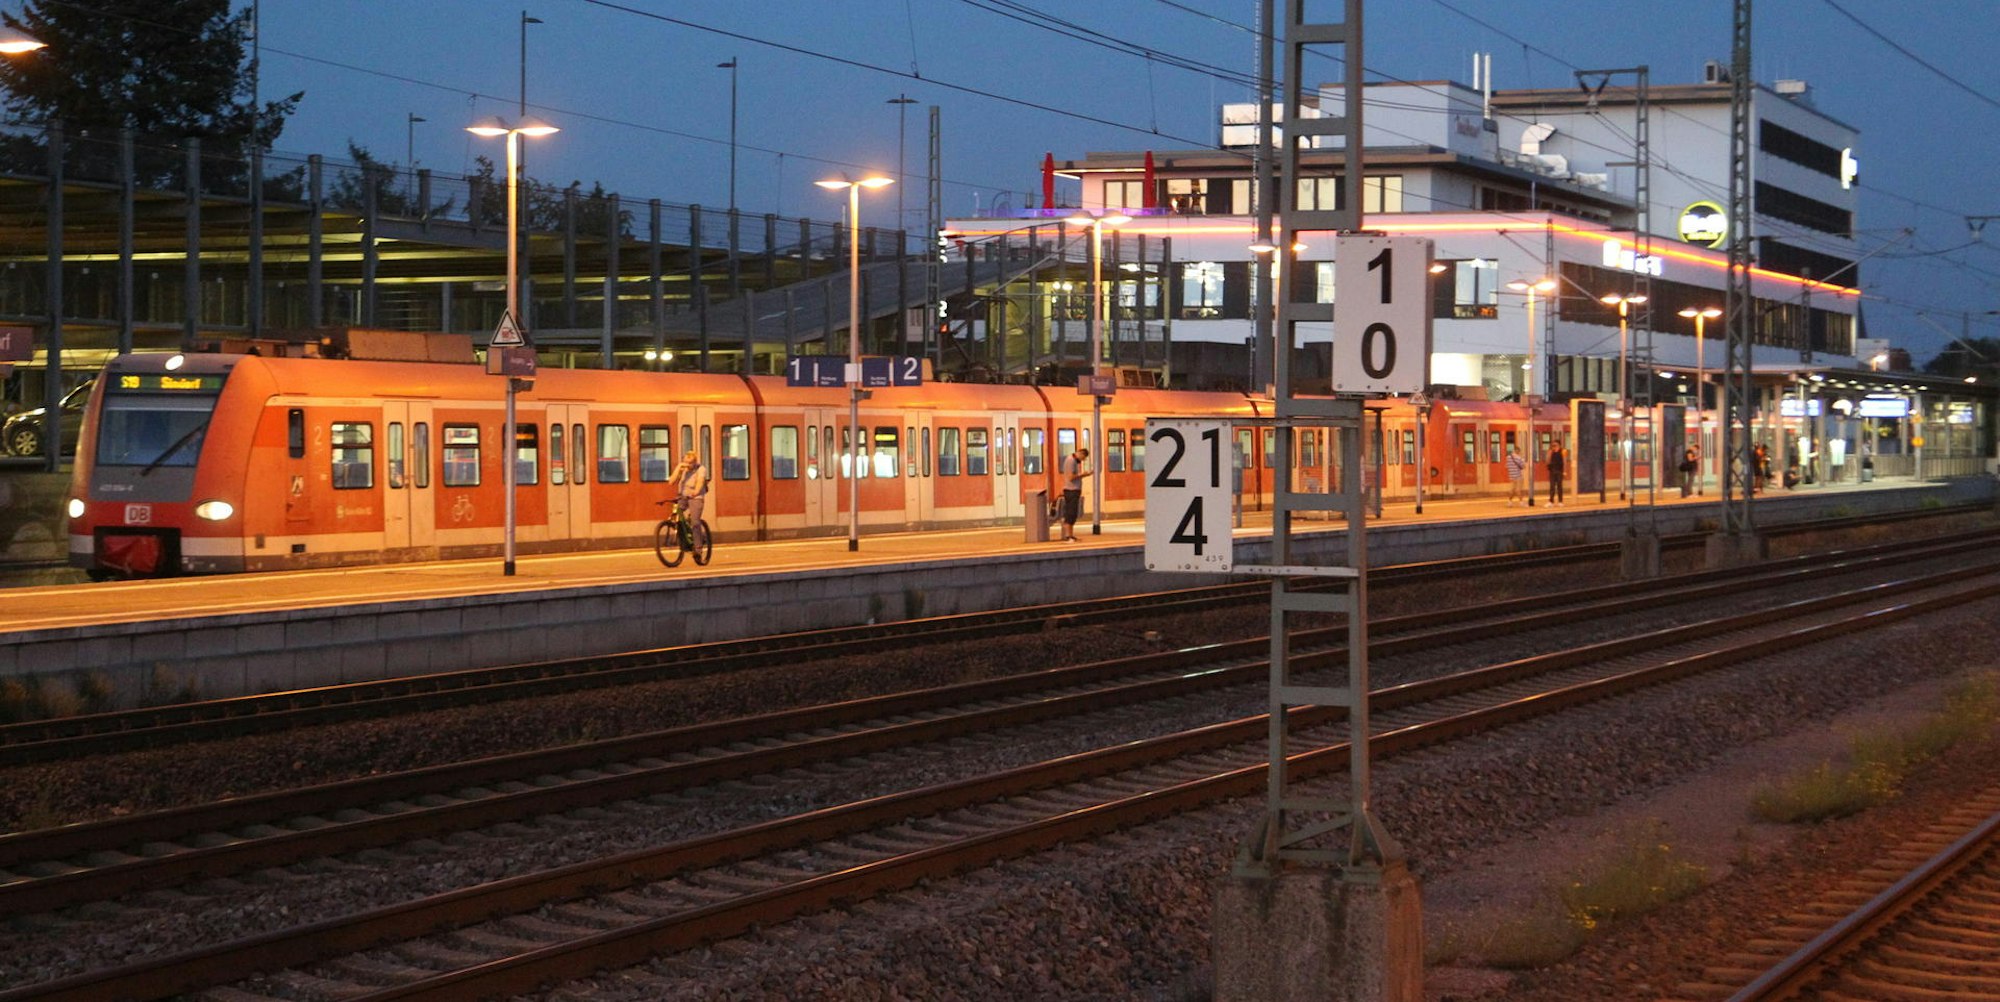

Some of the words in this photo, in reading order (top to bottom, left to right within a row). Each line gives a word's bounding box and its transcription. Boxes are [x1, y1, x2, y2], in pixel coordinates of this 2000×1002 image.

[1367, 248, 1392, 304] 1
[790, 358, 800, 381] 1
[903, 357, 918, 381] 2
[1361, 322, 1397, 380] 0
[1149, 427, 1220, 488] 21
[128, 506, 149, 521] DB
[1168, 496, 1208, 556] 4
